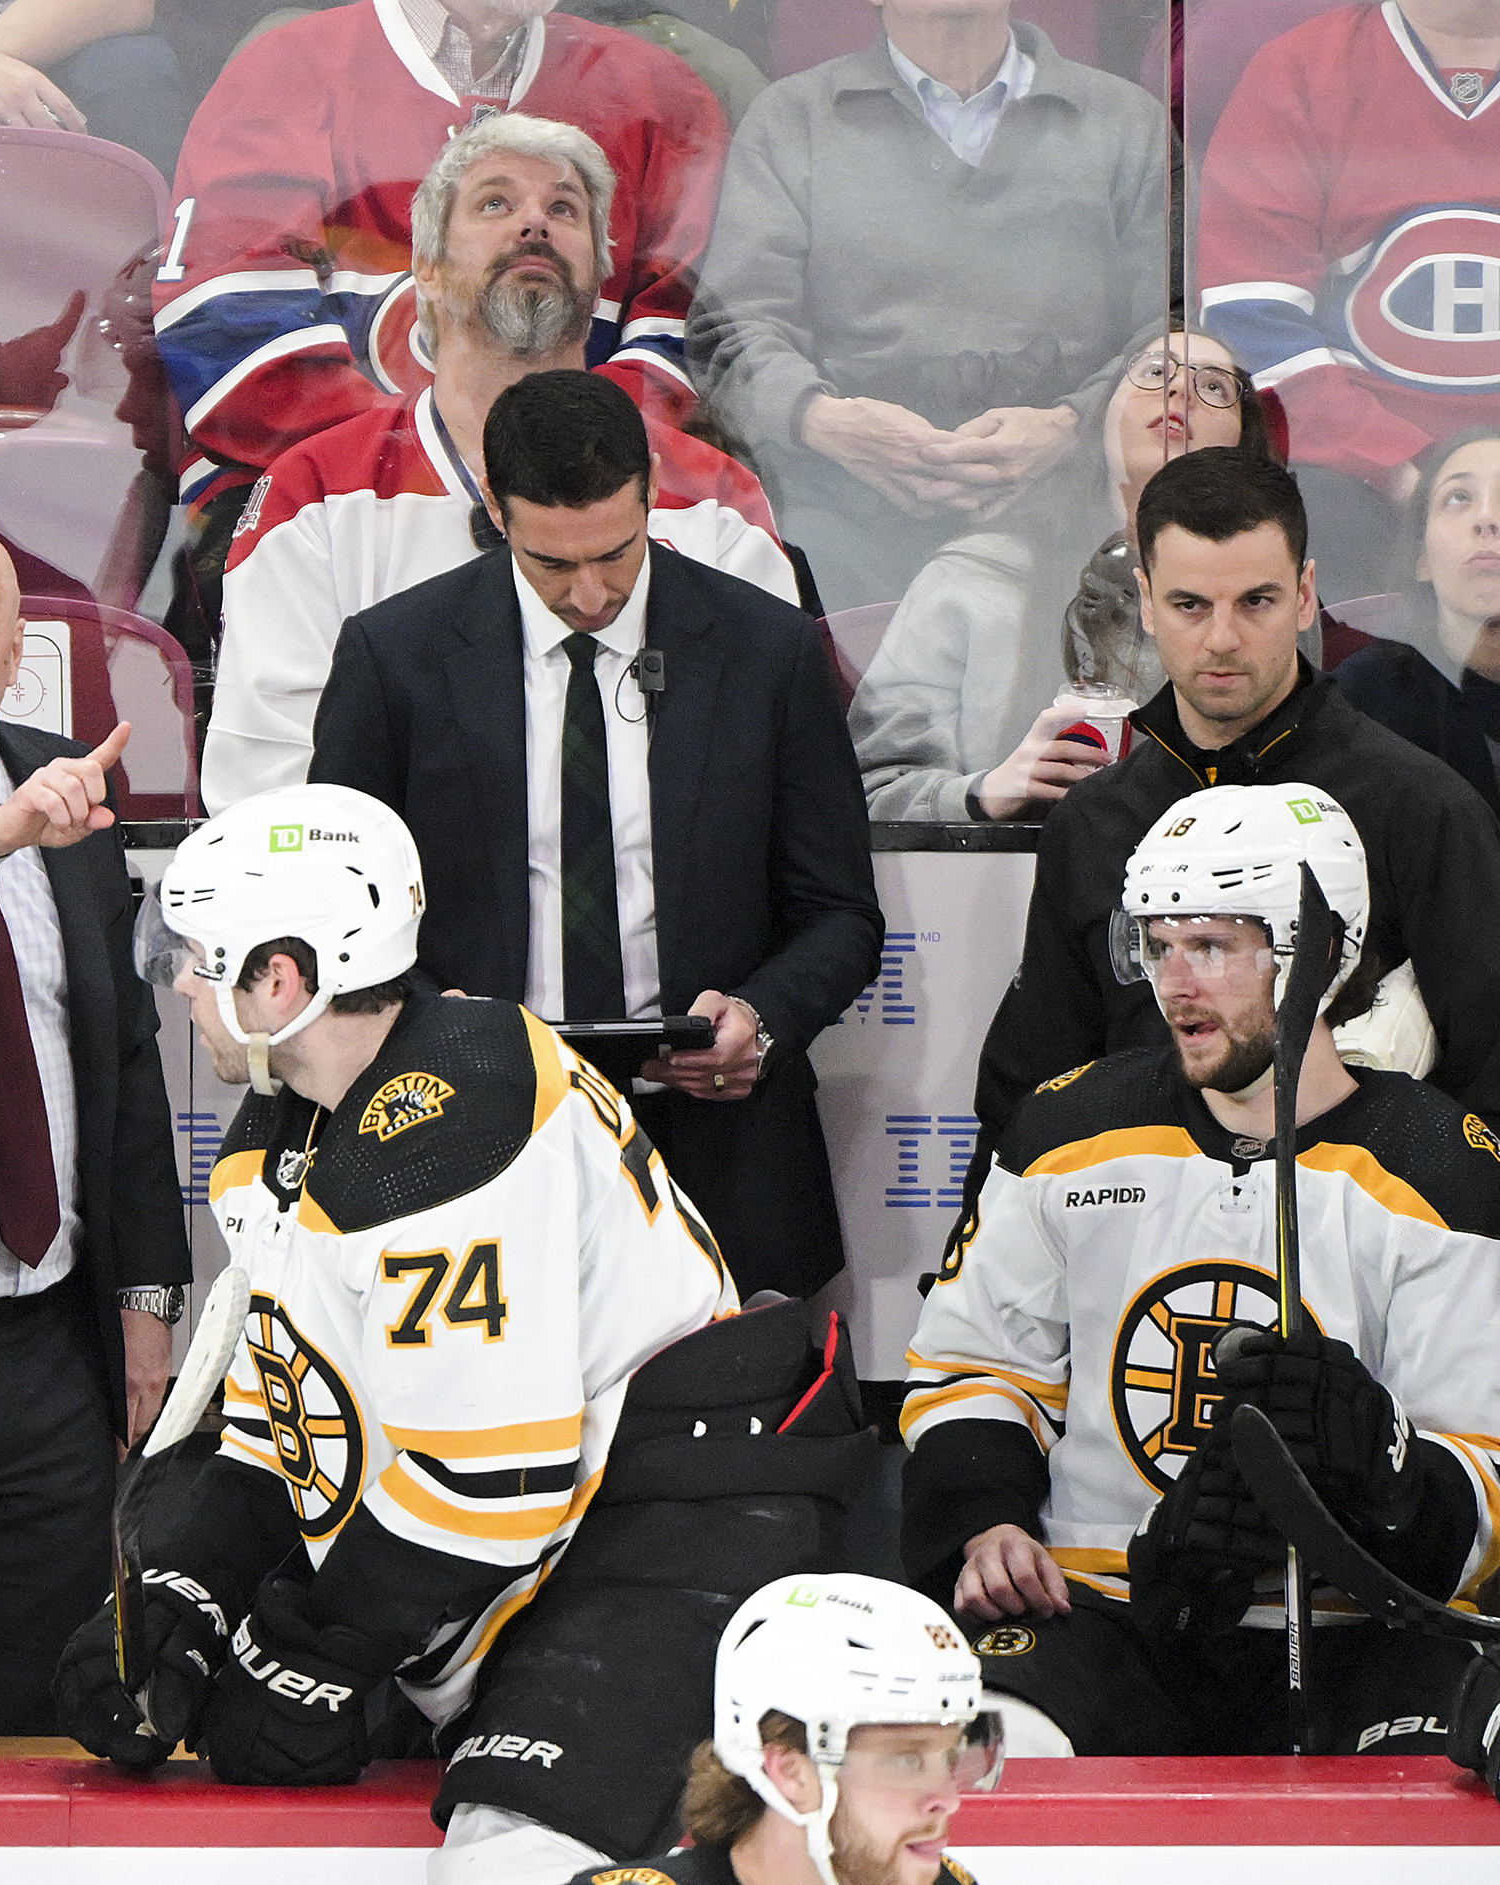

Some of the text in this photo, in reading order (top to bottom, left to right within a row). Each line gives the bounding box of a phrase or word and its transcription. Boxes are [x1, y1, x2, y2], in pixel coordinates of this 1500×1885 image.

[1317, 801, 1345, 814] Ban
[1162, 816, 1197, 838] 18
[270, 827, 361, 850] TD Bank
[920, 931, 941, 943] MD
[362, 1074, 451, 1130] BOSTON
[381, 1238, 509, 1349] 74
